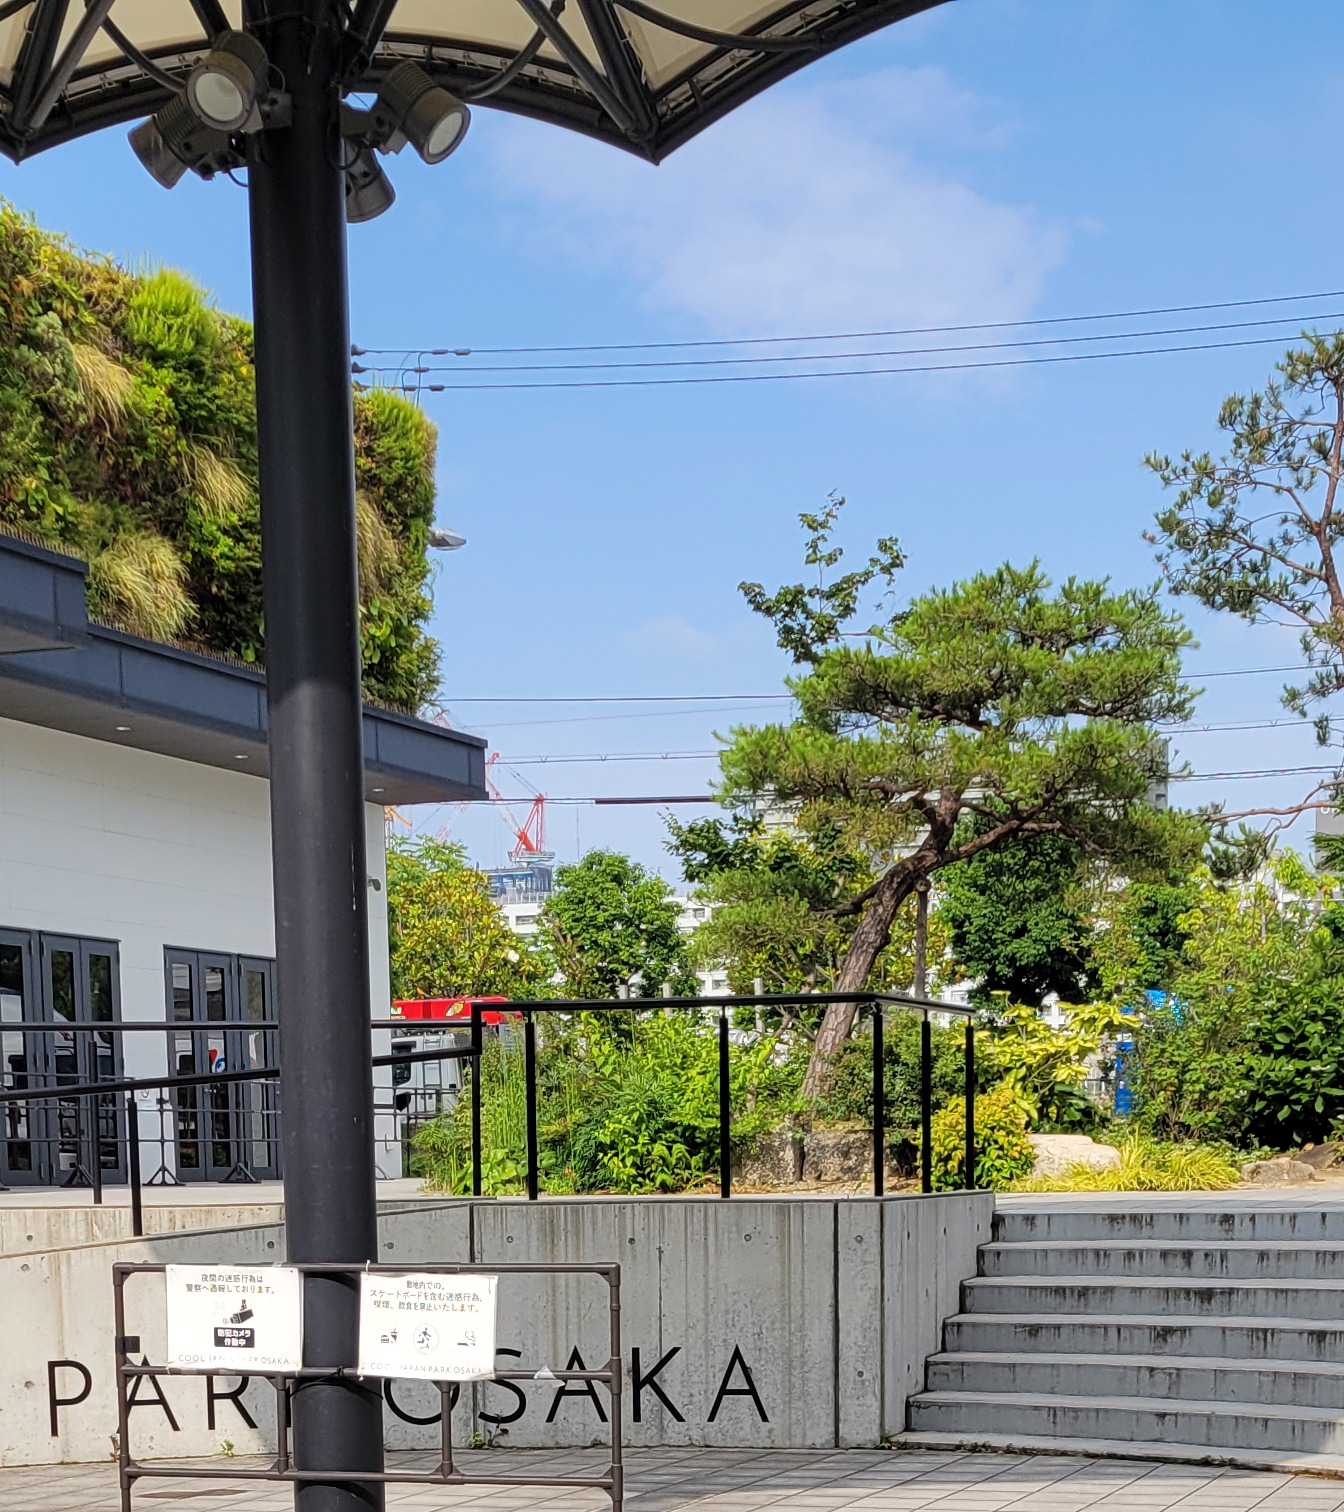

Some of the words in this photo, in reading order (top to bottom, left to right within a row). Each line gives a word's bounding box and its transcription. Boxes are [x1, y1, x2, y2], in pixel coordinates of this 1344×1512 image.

[201, 1273, 264, 1283] 夜間の迷惑行為は
[260, 1356, 290, 1365] OSAKA
[453, 1366, 483, 1376] OSAKA
[47, 1354, 293, 1438] PAR
